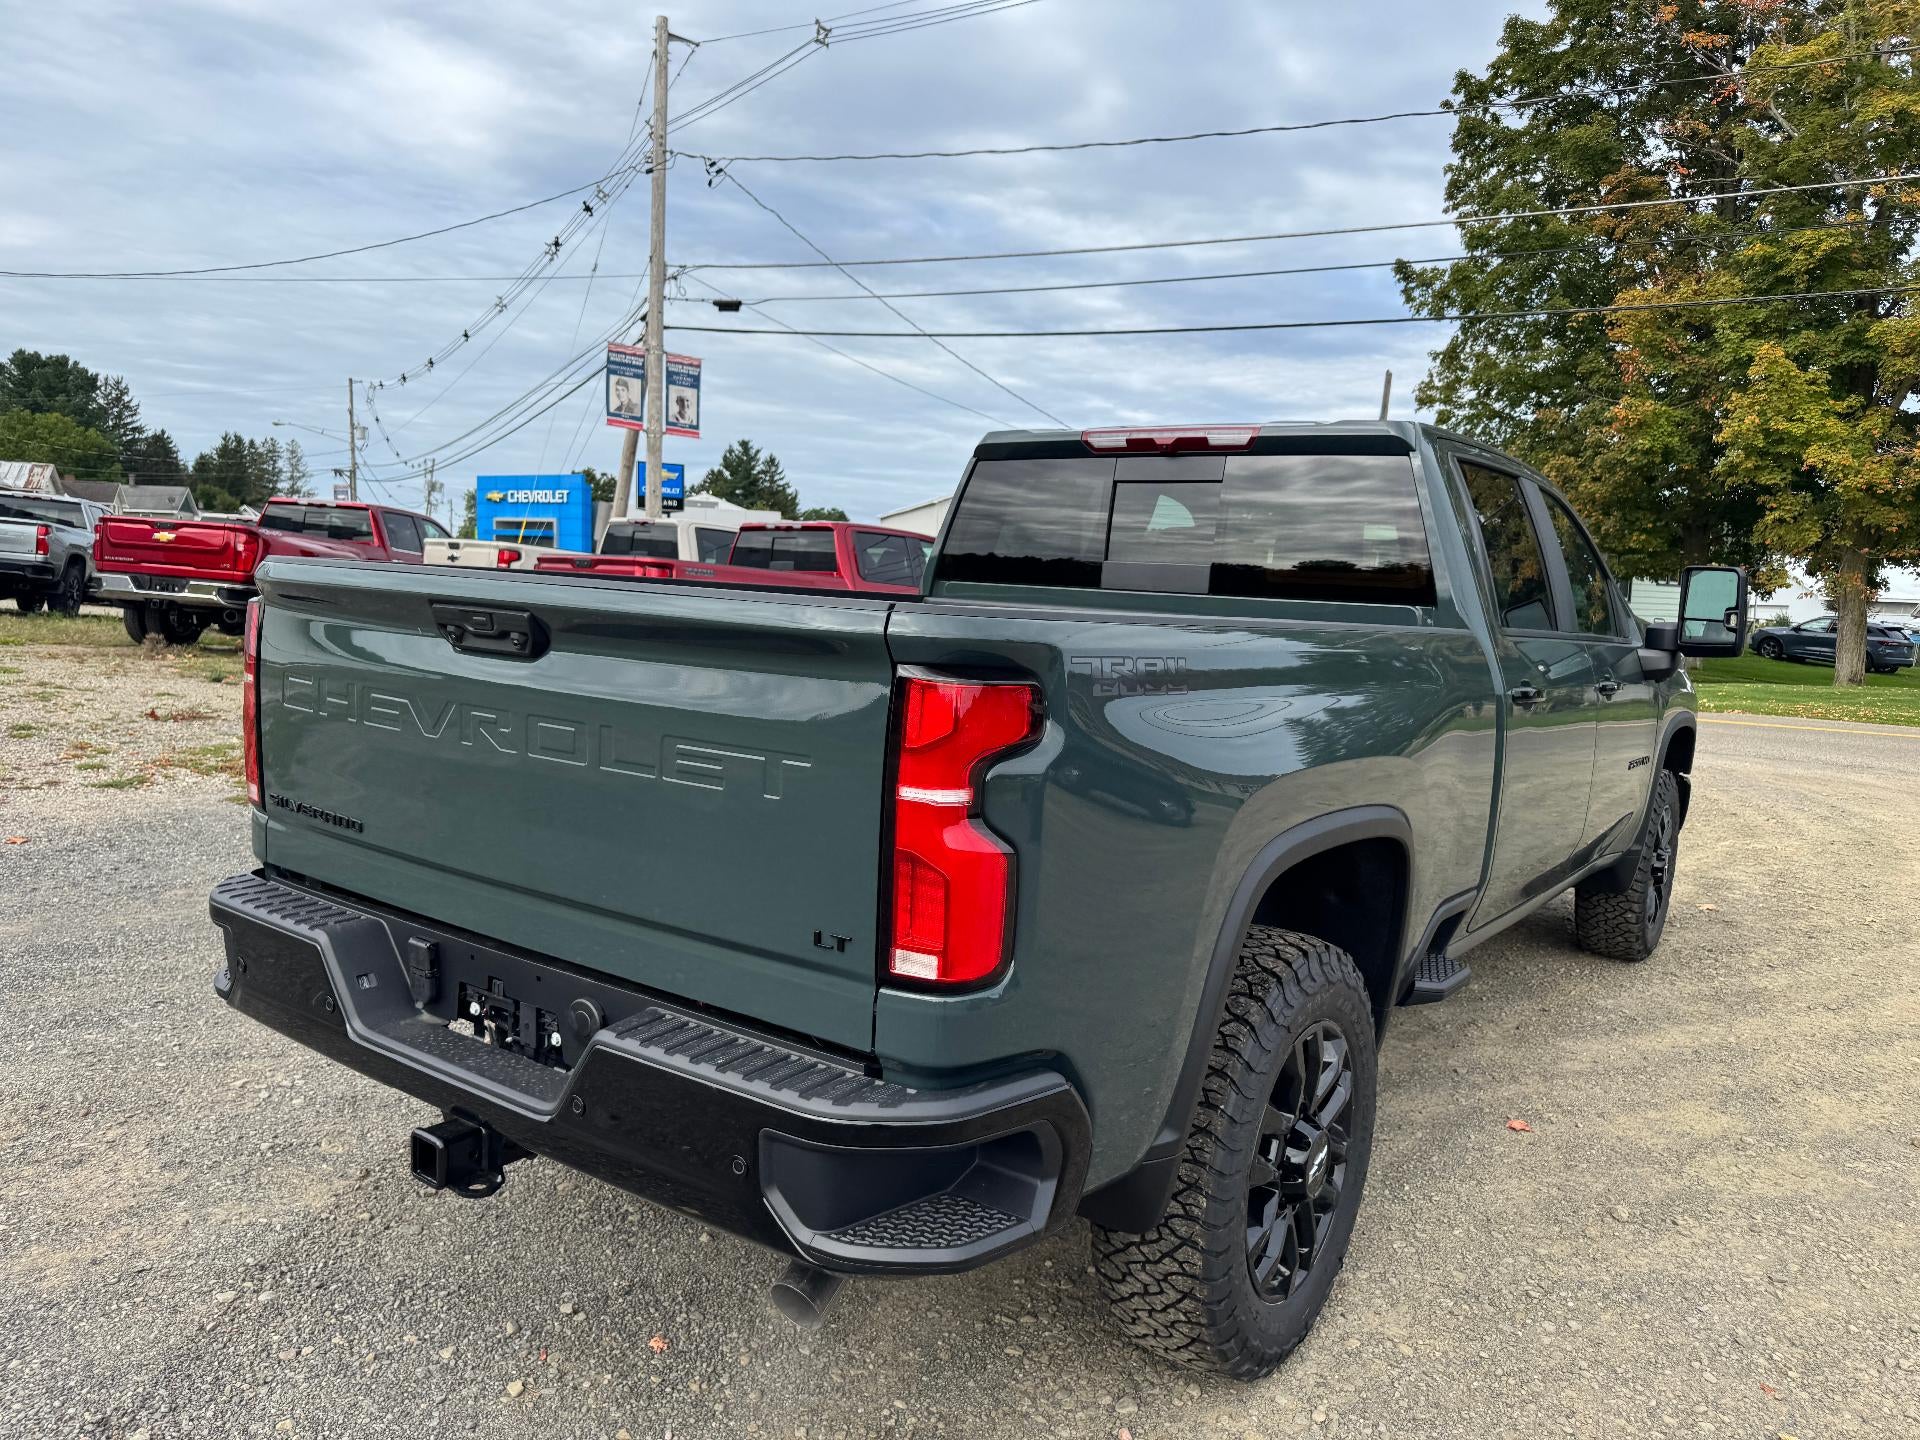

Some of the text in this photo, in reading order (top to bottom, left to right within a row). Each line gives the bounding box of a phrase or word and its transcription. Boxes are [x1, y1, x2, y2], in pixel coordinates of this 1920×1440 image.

[508, 490, 570, 503] CHEVROLET
[282, 672, 812, 800] CHEVROLET
[270, 793, 363, 833] SILVERADO
[814, 930, 853, 952] LT
